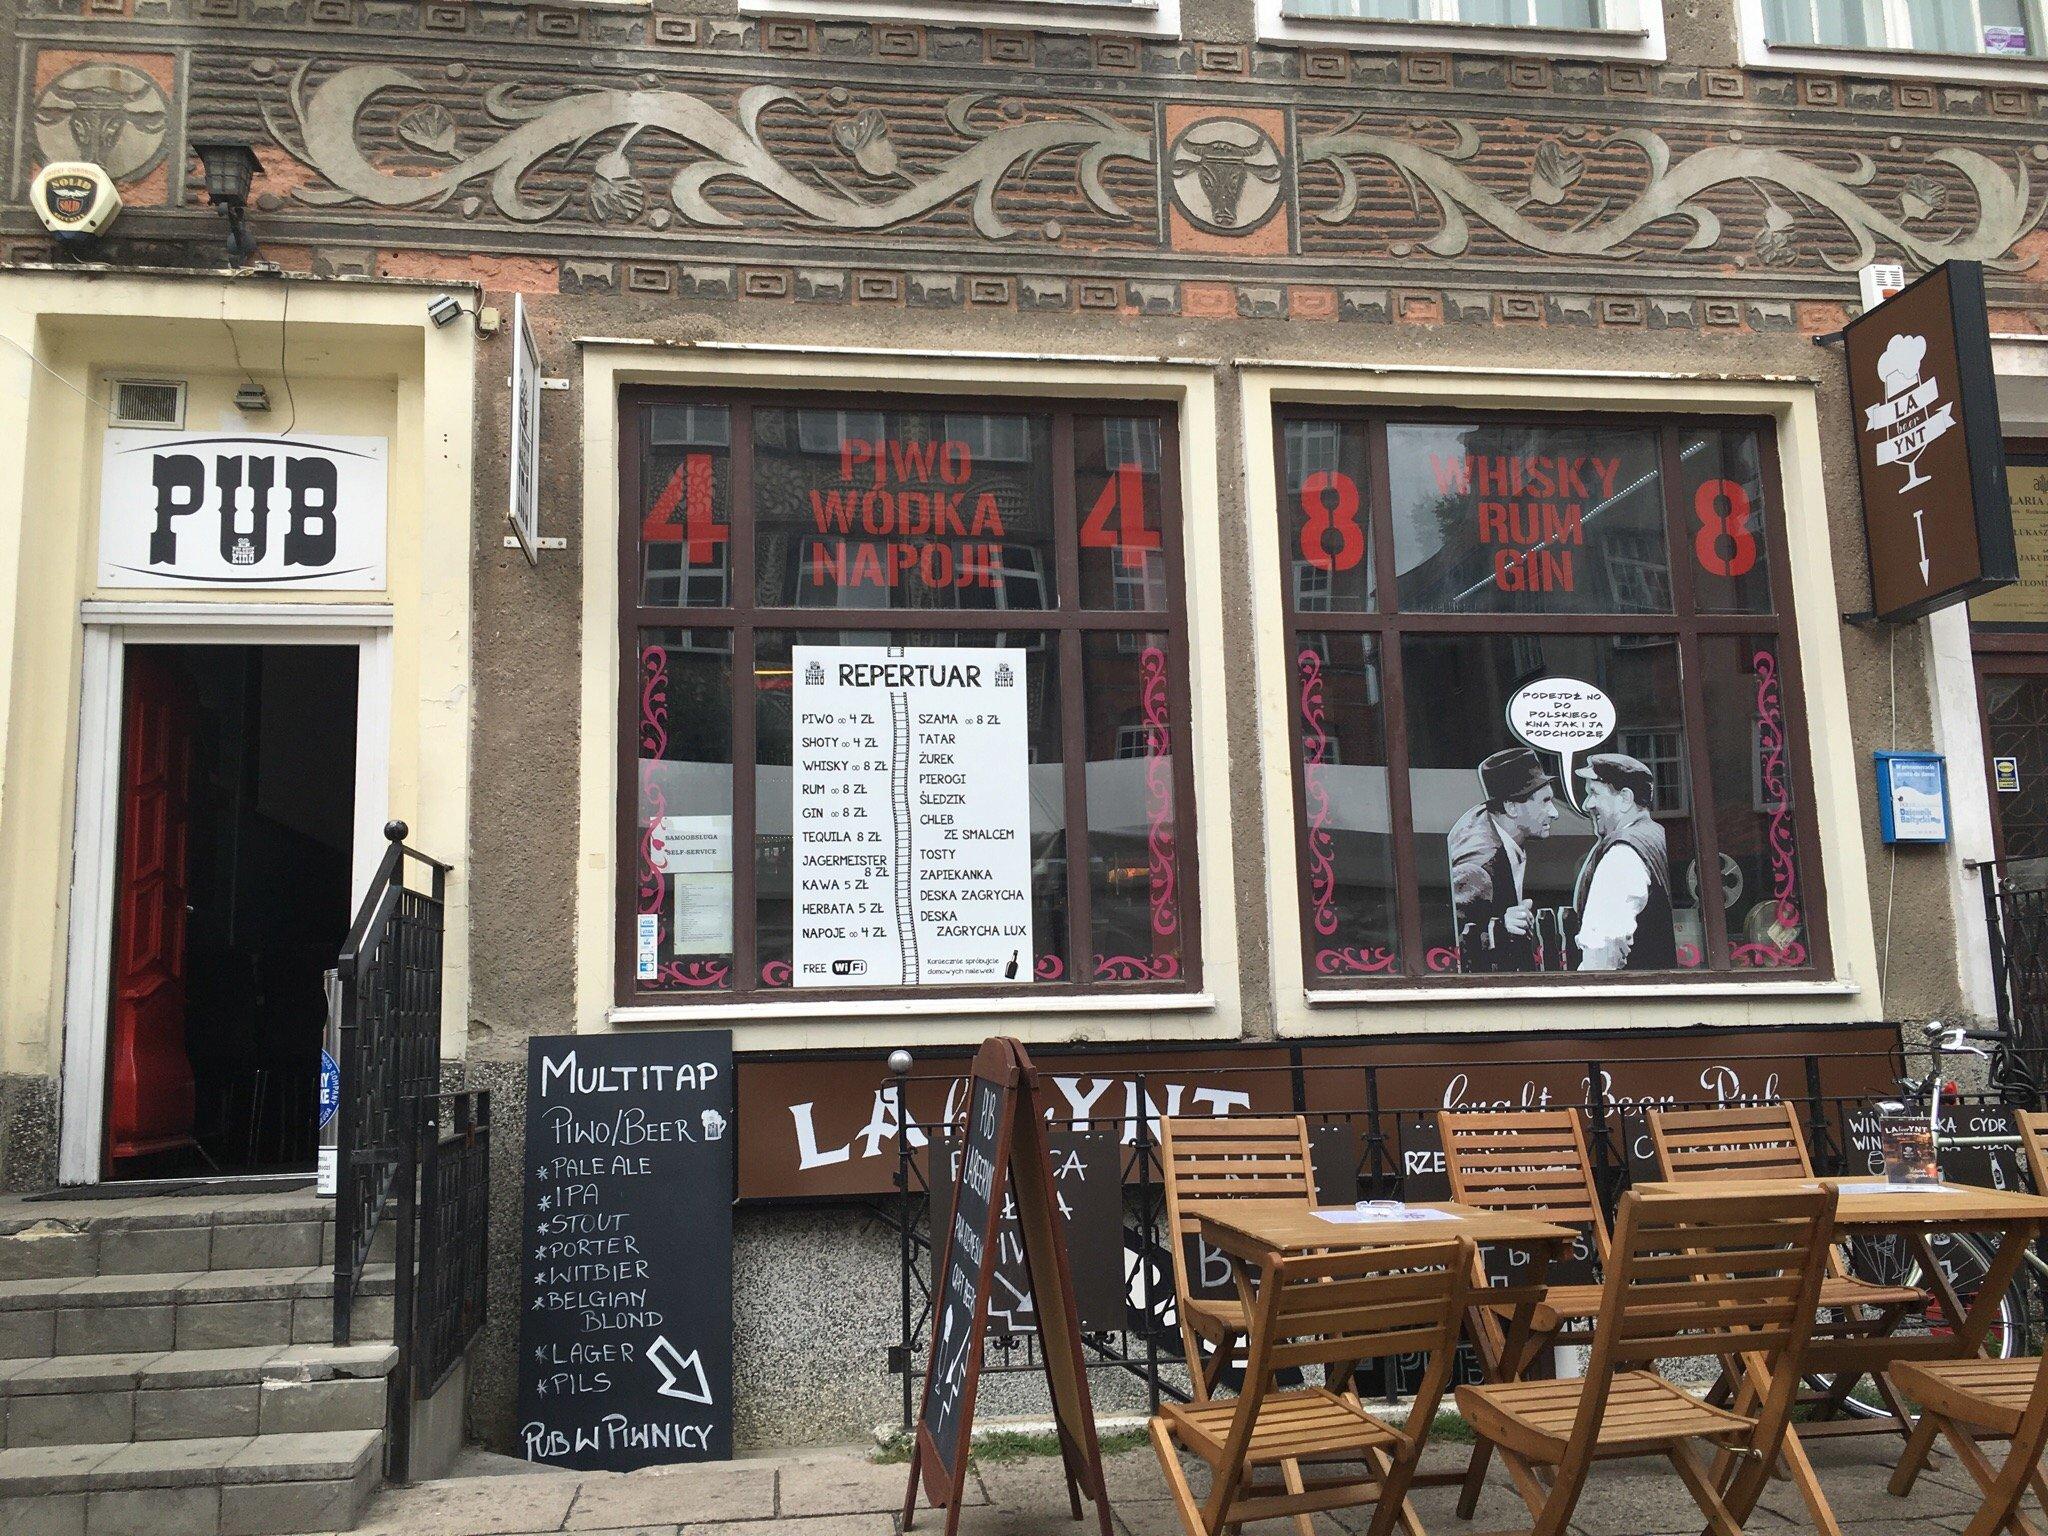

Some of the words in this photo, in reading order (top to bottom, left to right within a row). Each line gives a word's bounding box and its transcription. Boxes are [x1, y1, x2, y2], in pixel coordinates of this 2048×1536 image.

[51, 178, 91, 190] SOLID
[1894, 394, 1918, 419] LA
[1896, 416, 1920, 435] beer
[1894, 426, 1926, 455] YNT
[841, 439, 972, 485] PIWO
[1429, 452, 1621, 499] WHISKY
[149, 454, 338, 566] PUB
[643, 453, 728, 564] 4
[809, 484, 1004, 537] WÓDKA
[1080, 463, 1160, 568] 4
[1301, 471, 1364, 571] 8
[1478, 502, 1585, 547] RUM
[1695, 479, 1757, 577] 8
[813, 541, 1003, 589] NAPOJE
[1495, 549, 1574, 592] GIN
[838, 663, 982, 688] REPERTUAR
[802, 714, 834, 724] PIWO
[850, 714, 857, 724] 4
[861, 714, 875, 724] ZŁ
[919, 714, 958, 724] SZAMA
[977, 715, 983, 724] 8
[987, 715, 1001, 724] ZŁ
[802, 737, 839, 748] SHOTY
[853, 738, 860, 747] 4
[865, 738, 878, 747] ZŁ
[919, 734, 956, 744] TATAR
[803, 760, 849, 771] WHISKY
[864, 761, 870, 771] 8
[874, 761, 888, 771] ZŁ
[919, 751, 954, 764] ŻUREK
[919, 774, 966, 784] PIEROGI
[802, 784, 825, 794] RUM
[843, 784, 850, 794] 8
[854, 784, 867, 794] ZŁ
[919, 791, 966, 805] ŚLEDZIK
[802, 807, 823, 818] GIN
[843, 807, 850, 817] 8
[854, 807, 867, 817] ZŁ
[920, 814, 954, 825] CHLEB
[803, 831, 851, 843] TEQUILA
[857, 832, 864, 841] 8
[868, 832, 882, 841] ZŁ
[944, 829, 958, 840] ZE
[962, 829, 1014, 840] SMALCEM
[803, 855, 887, 866] JAGERMEISTER
[920, 849, 956, 859] TOSTY
[865, 867, 871, 877] 8
[876, 867, 889, 877] ZŁ
[920, 869, 993, 880] ZAPIEKANKA
[803, 879, 840, 890] KAWA
[844, 880, 851, 889] 5
[855, 879, 869, 889] ZŁ
[920, 890, 957, 901] DESKA
[961, 890, 1024, 901] ZAGRYCHA
[803, 903, 854, 914] HERBATA
[859, 903, 866, 913] 5
[870, 903, 884, 913] ZŁ
[920, 911, 958, 921] DESKA
[803, 928, 845, 938] NAPOJE
[861, 927, 868, 937] 4
[873, 927, 887, 937] ZŁ
[937, 926, 1000, 936] ZAGRYCHA
[1004, 925, 1027, 936] LUX
[803, 964, 827, 973] FREE
[541, 1050, 718, 1097] MULTITAP
[542, 1106, 697, 1146] PIWO/BEER
[1970, 1117, 2008, 1133] CYDR
[551, 1157, 605, 1178] PALE
[611, 1155, 651, 1176] ALE
[557, 1183, 598, 1206] IPA
[552, 1213, 630, 1233] STOUT
[549, 1236, 639, 1259] PORTER
[550, 1260, 649, 1284] WITBIER
[547, 1289, 646, 1310] BELGIAN
[580, 1310, 663, 1332] BLOND
[553, 1343, 634, 1364] LAGER
[551, 1373, 611, 1395] PILS
[521, 1421, 570, 1462] PUB
[575, 1426, 599, 1453] W
[602, 1413, 713, 1451] PIWNICY
